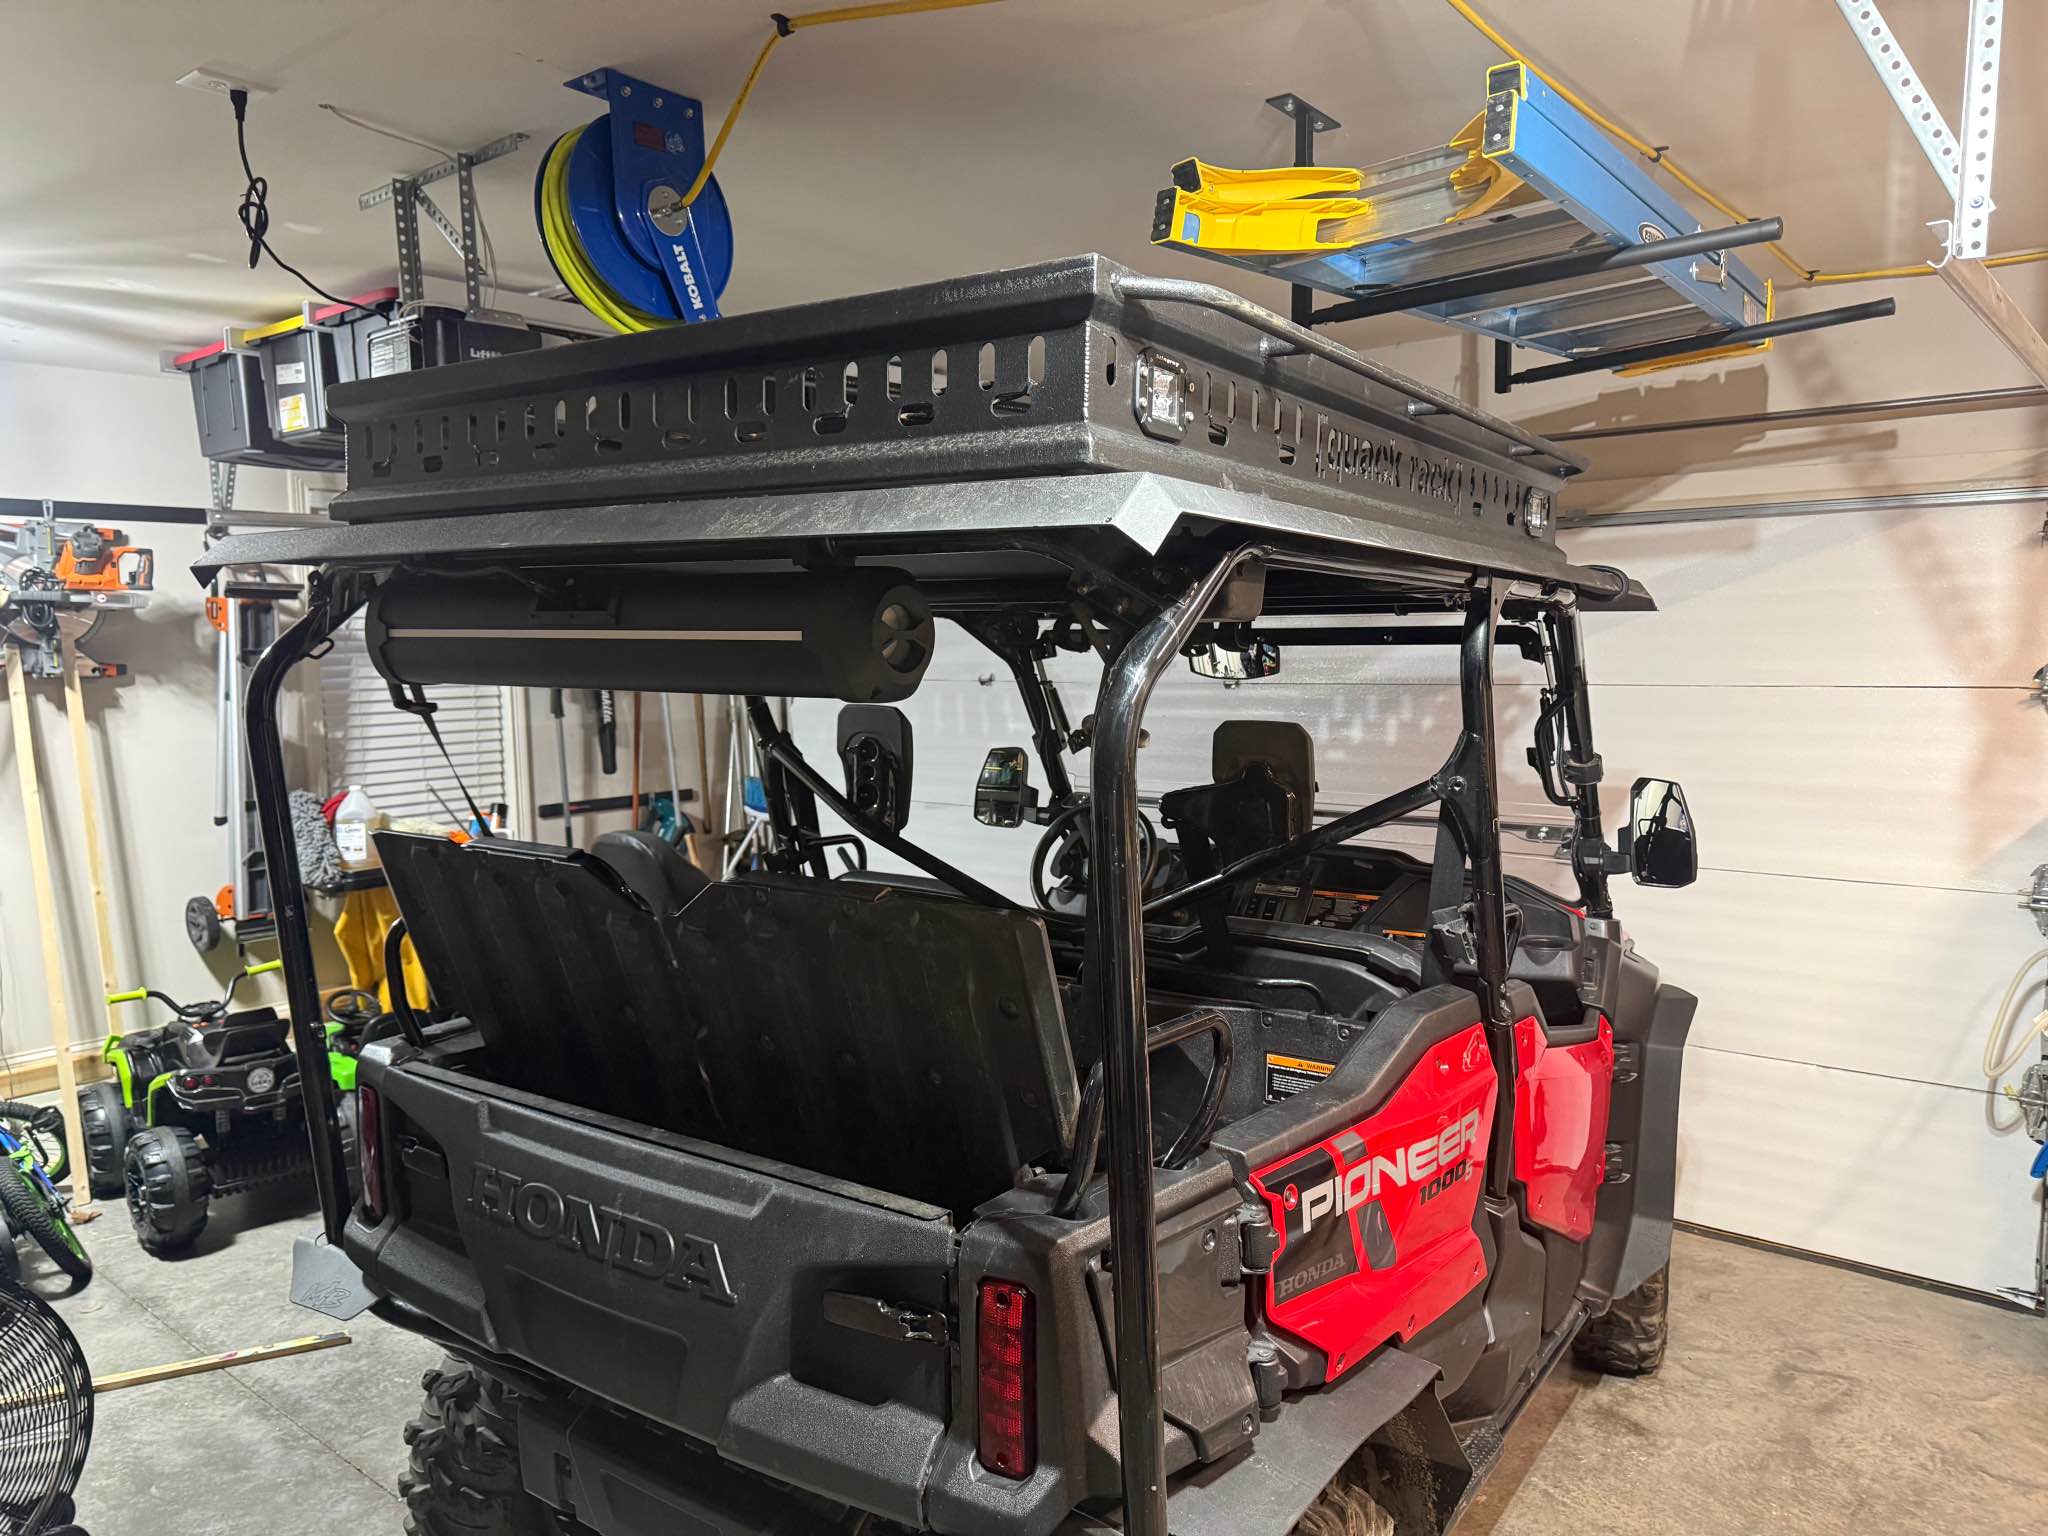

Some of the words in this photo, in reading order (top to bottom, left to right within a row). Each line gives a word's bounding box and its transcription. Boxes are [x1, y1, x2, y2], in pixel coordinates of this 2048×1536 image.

[673, 244, 704, 310] KOBALT
[601, 689, 614, 725] akita
[1302, 1107, 1480, 1234] PIONEER
[467, 1161, 737, 1307] HONDA
[1279, 1253, 1346, 1298] HONDA
